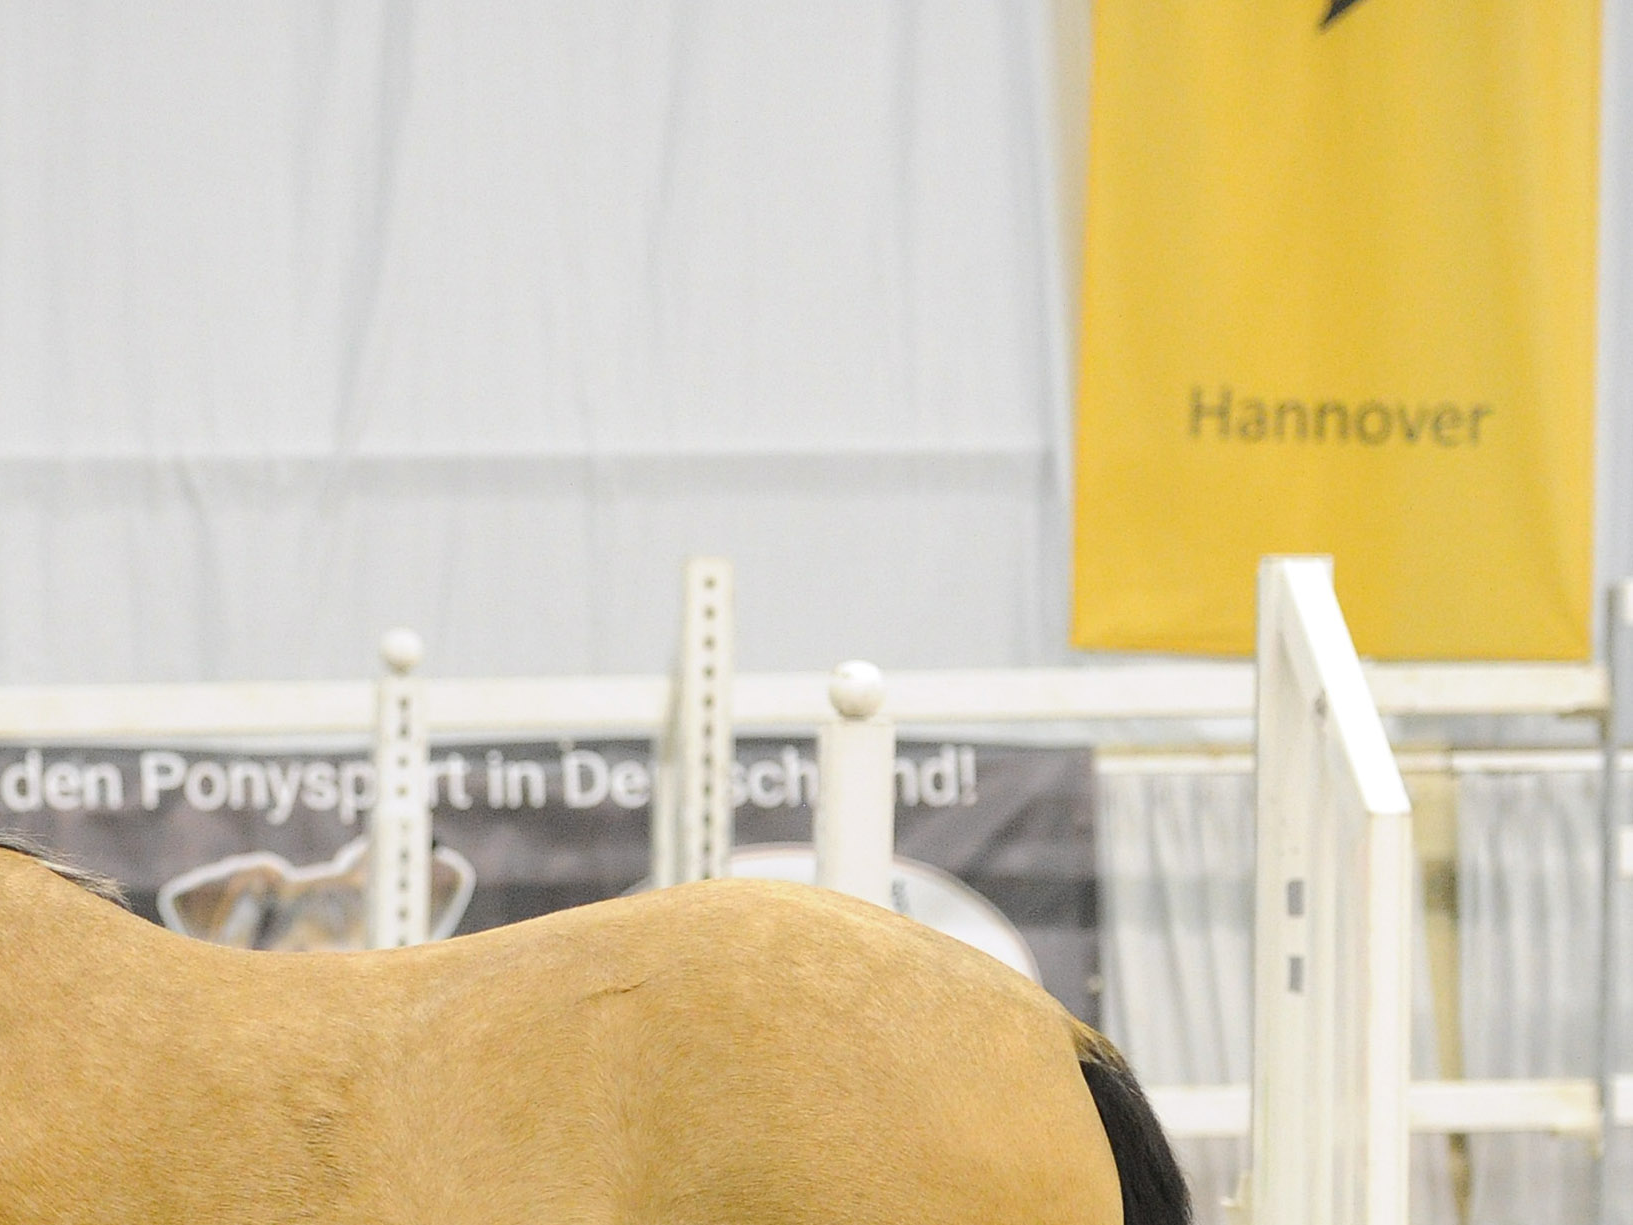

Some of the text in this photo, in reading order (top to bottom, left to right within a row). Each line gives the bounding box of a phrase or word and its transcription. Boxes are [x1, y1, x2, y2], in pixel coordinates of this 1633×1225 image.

[1188, 386, 1493, 447] Hannover
[0, 750, 123, 811] den
[142, 752, 472, 825] Ponysprt
[486, 750, 547, 809] in
[563, 745, 978, 809] Deschnd!
